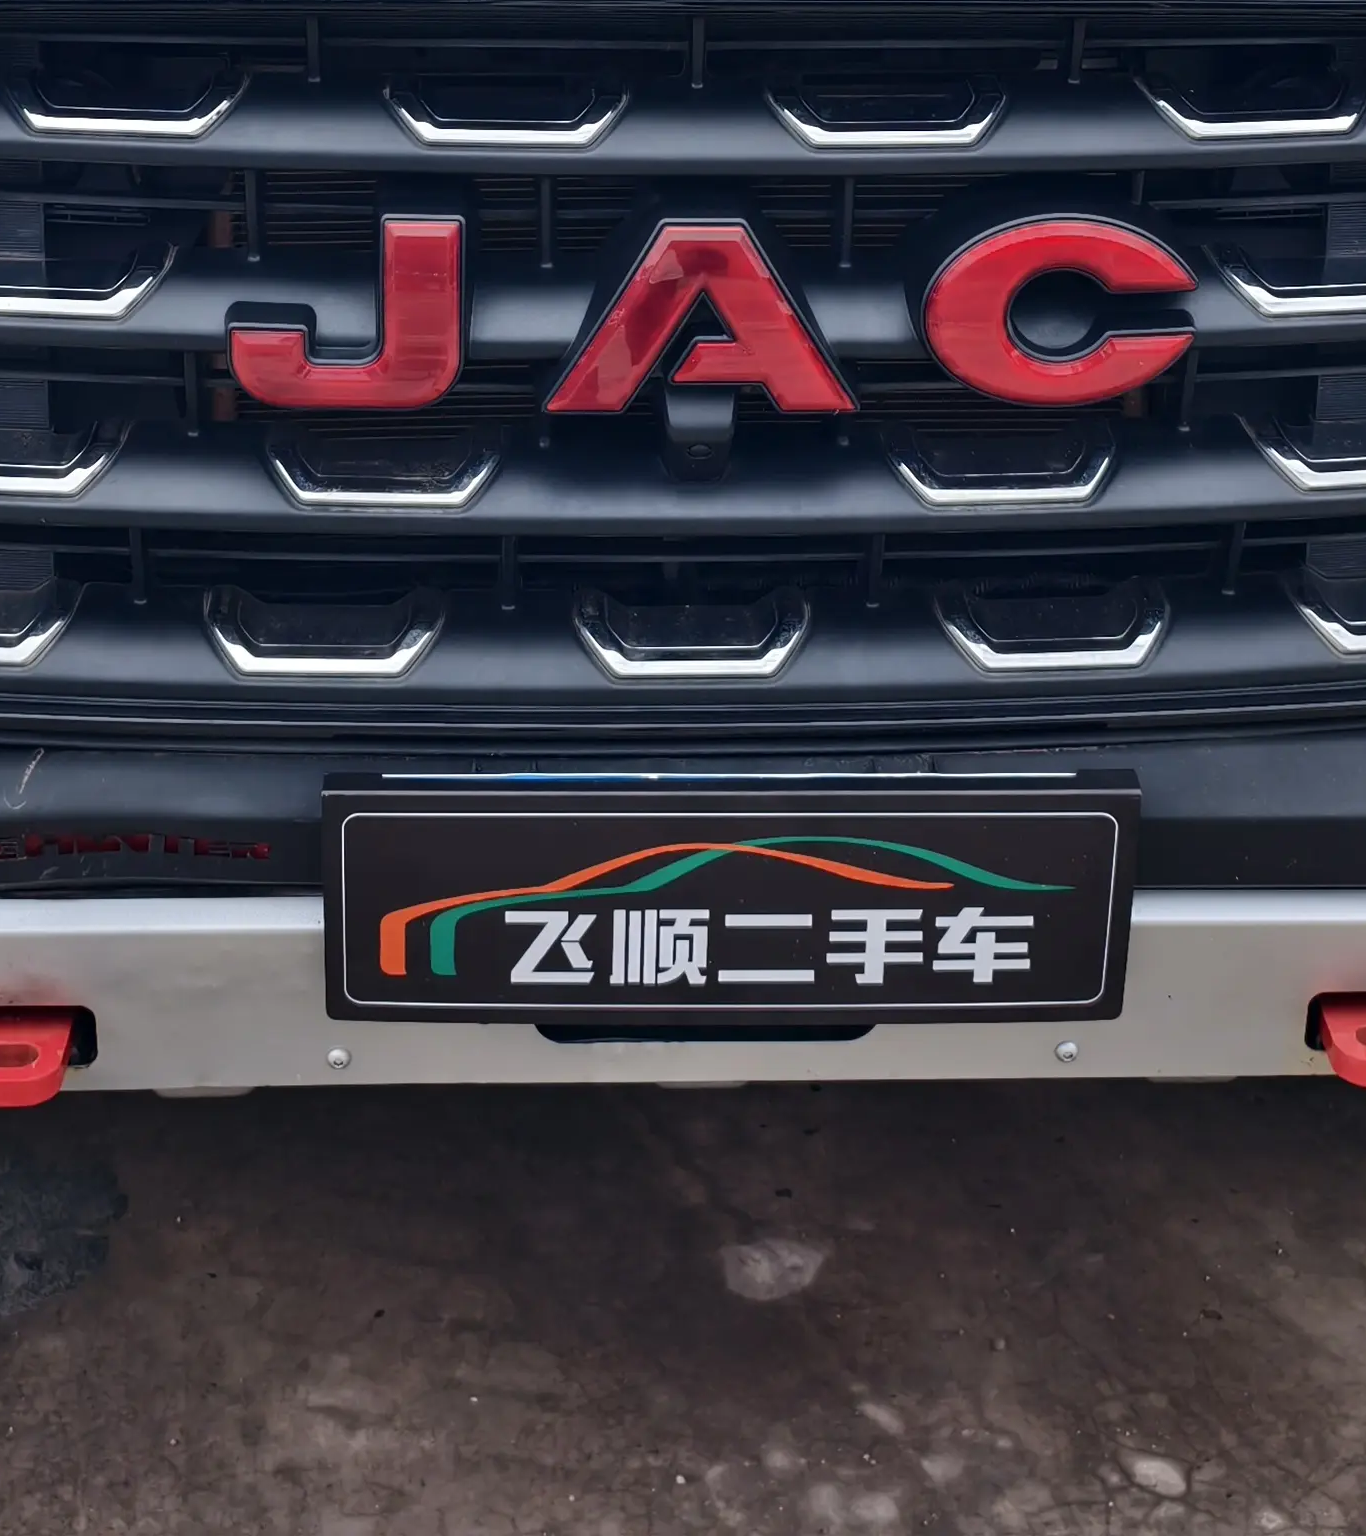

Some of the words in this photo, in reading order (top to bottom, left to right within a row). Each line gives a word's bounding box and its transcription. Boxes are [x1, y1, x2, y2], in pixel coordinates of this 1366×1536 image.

[227, 214, 1199, 413] JAC
[505, 906, 1034, 985] 飞顺二手车
